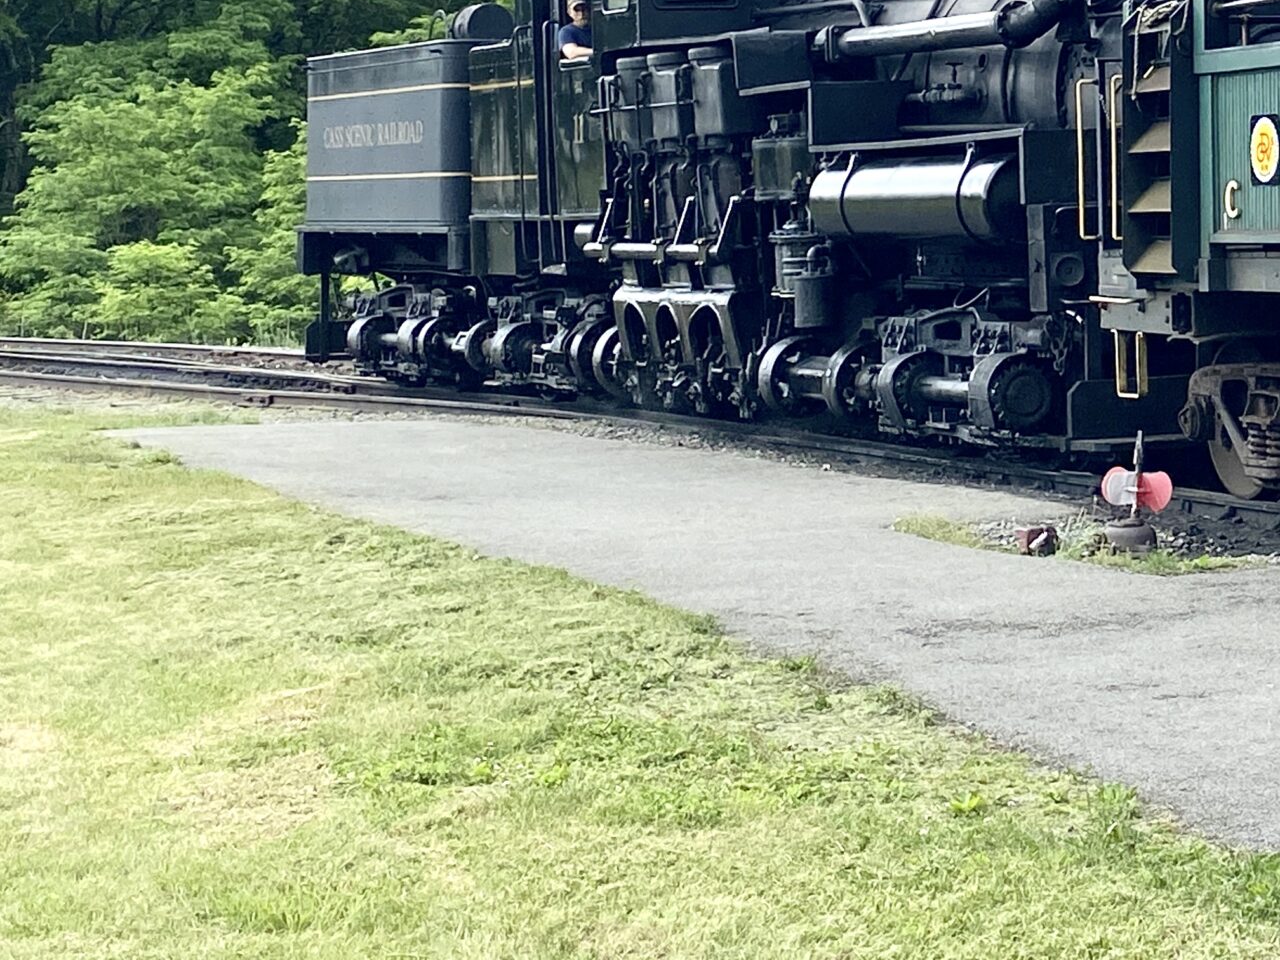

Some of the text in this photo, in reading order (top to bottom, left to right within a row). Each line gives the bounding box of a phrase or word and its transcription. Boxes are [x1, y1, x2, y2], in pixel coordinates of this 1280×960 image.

[323, 126, 344, 149] CASS
[377, 120, 424, 145] RAILROAD
[573, 113, 584, 144] 11
